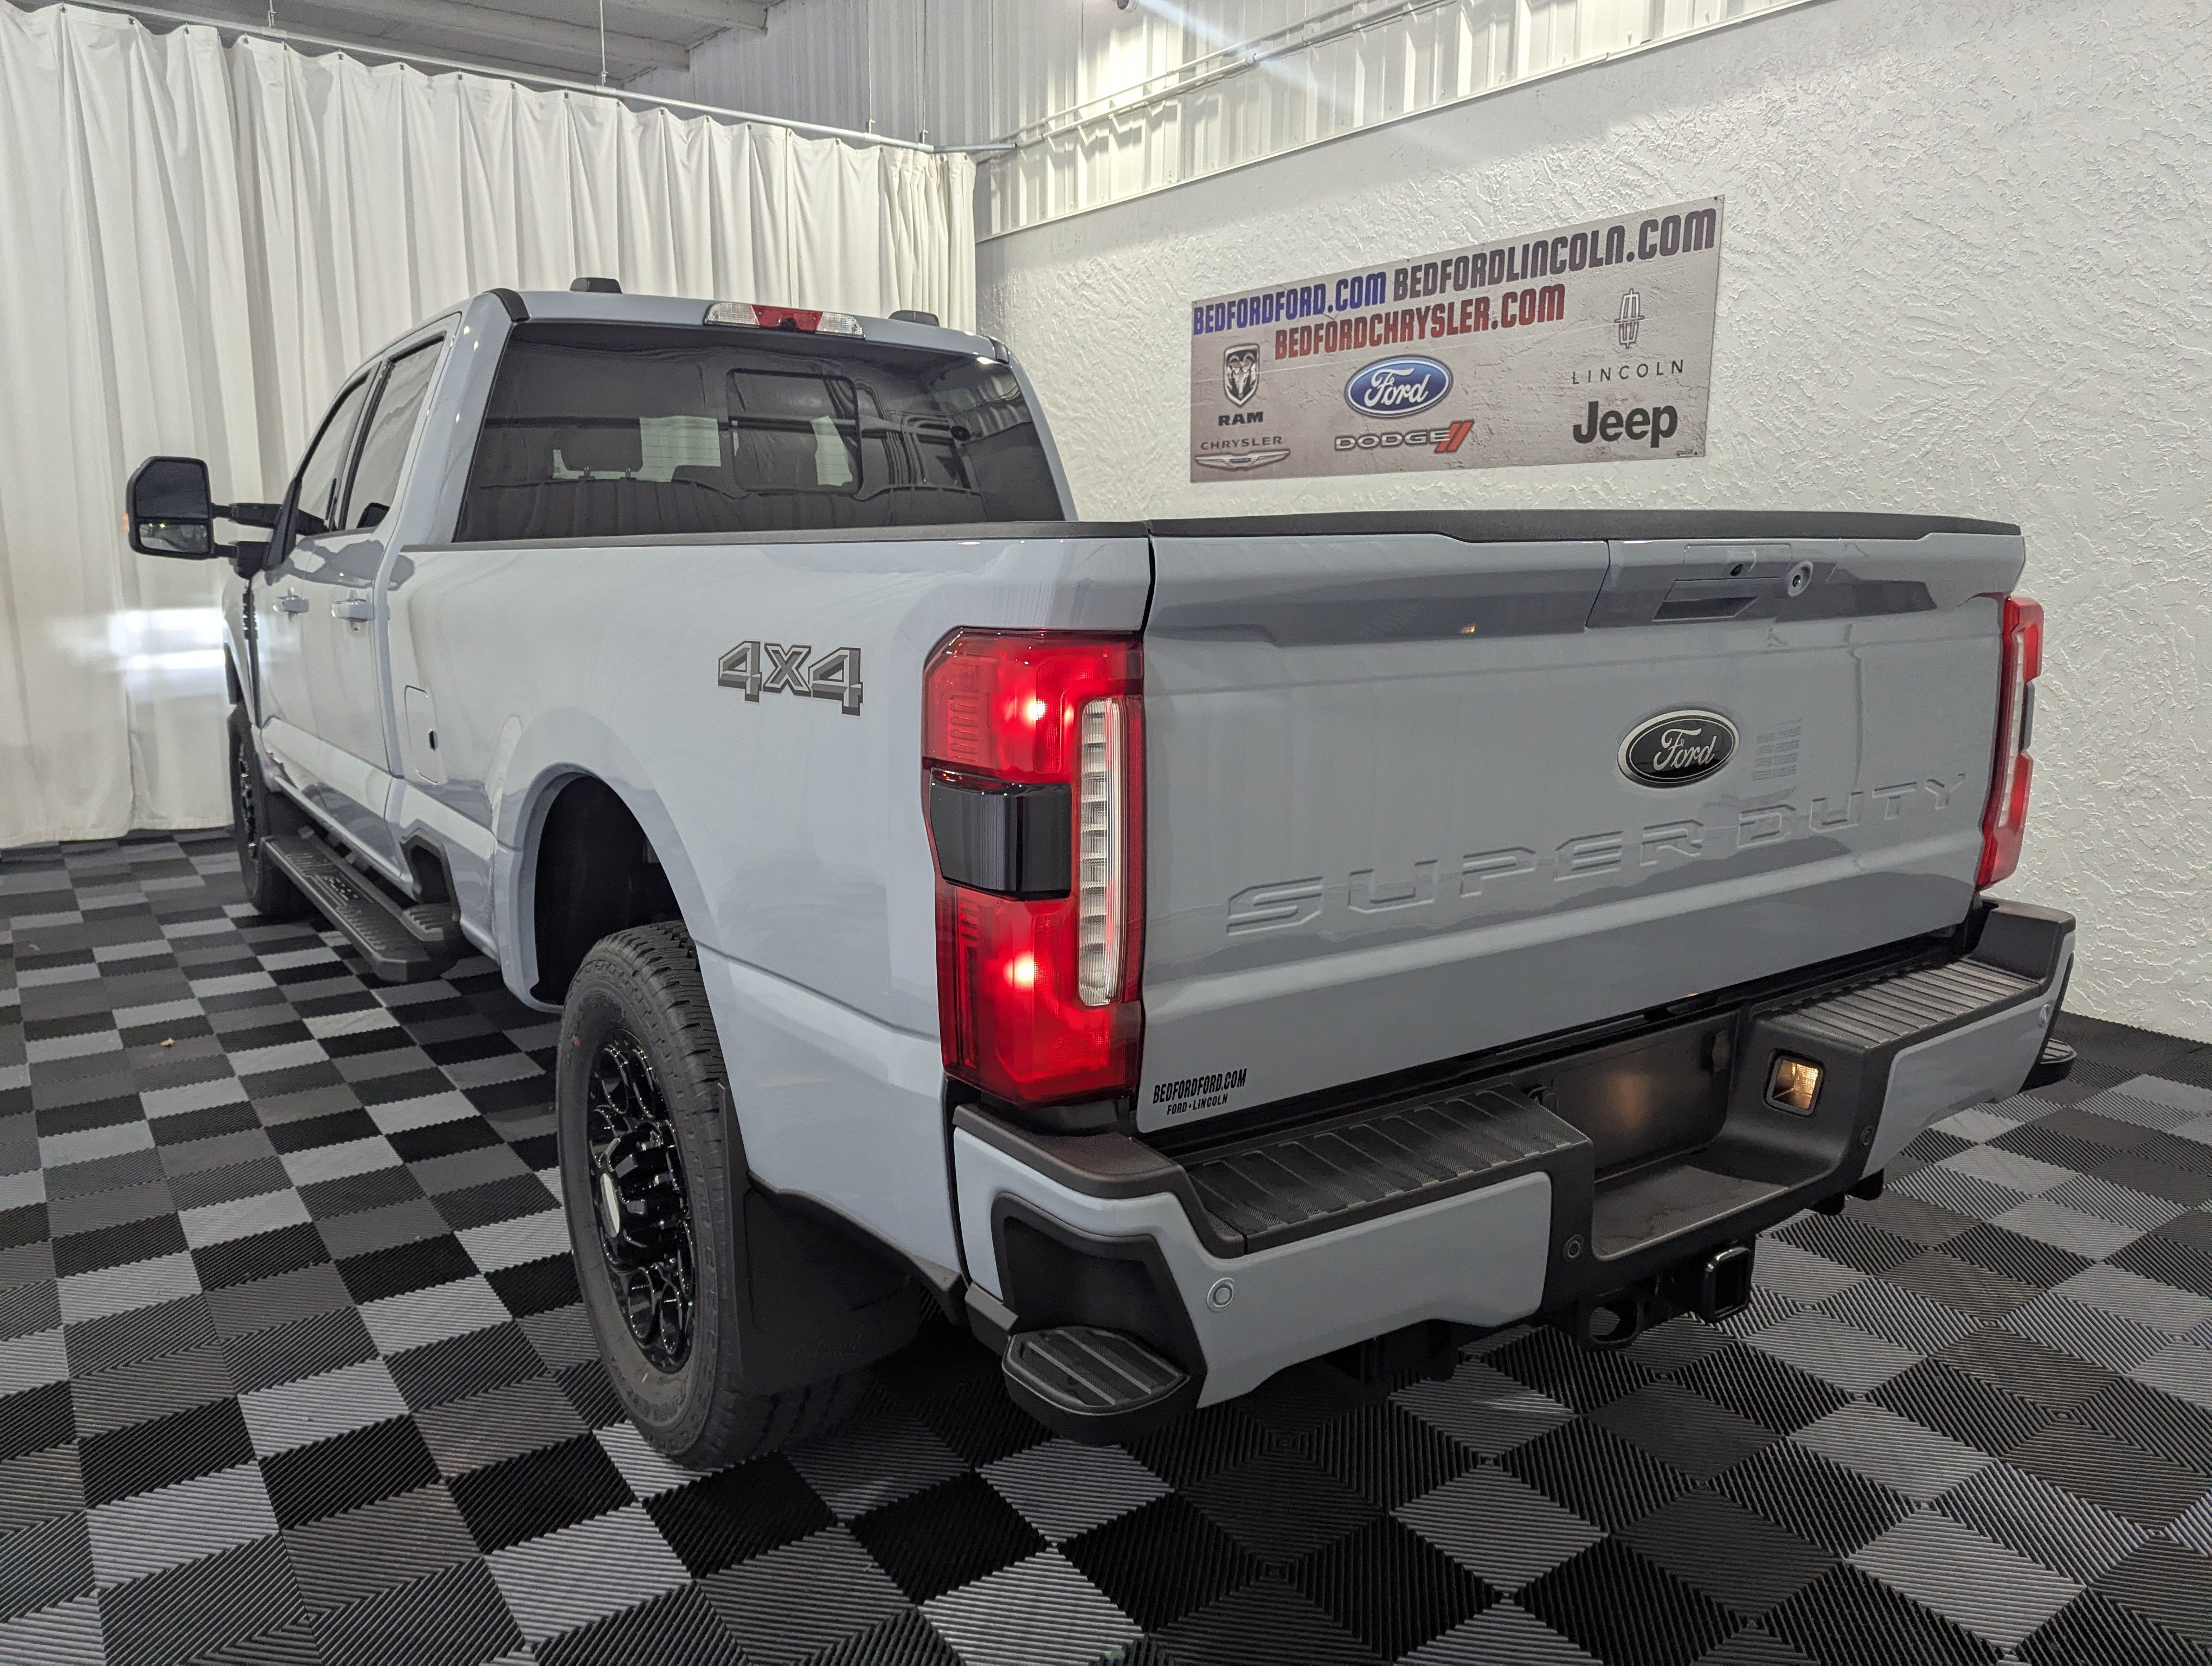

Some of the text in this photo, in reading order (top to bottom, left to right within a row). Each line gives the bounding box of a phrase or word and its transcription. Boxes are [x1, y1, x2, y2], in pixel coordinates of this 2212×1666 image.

[1193, 208, 1716, 335] BEDFORDFORD.COM BEDFORDLINCOLN.COM
[1275, 284, 1565, 360] BEDFORDCHRYSLER.COM
[1364, 368, 1431, 407] Ford
[1572, 360, 1683, 385] LINCOLN
[1218, 411, 1263, 426] RAM
[1573, 401, 1678, 448] Jeep
[1201, 436, 1282, 450] CHRYSLER
[1335, 427, 1450, 451] DODGE
[1653, 728, 1717, 771] Ford
[1226, 773, 1966, 936] SUPER DUTY
[1153, 1068, 1247, 1104] BEDFORDFORD.COM
